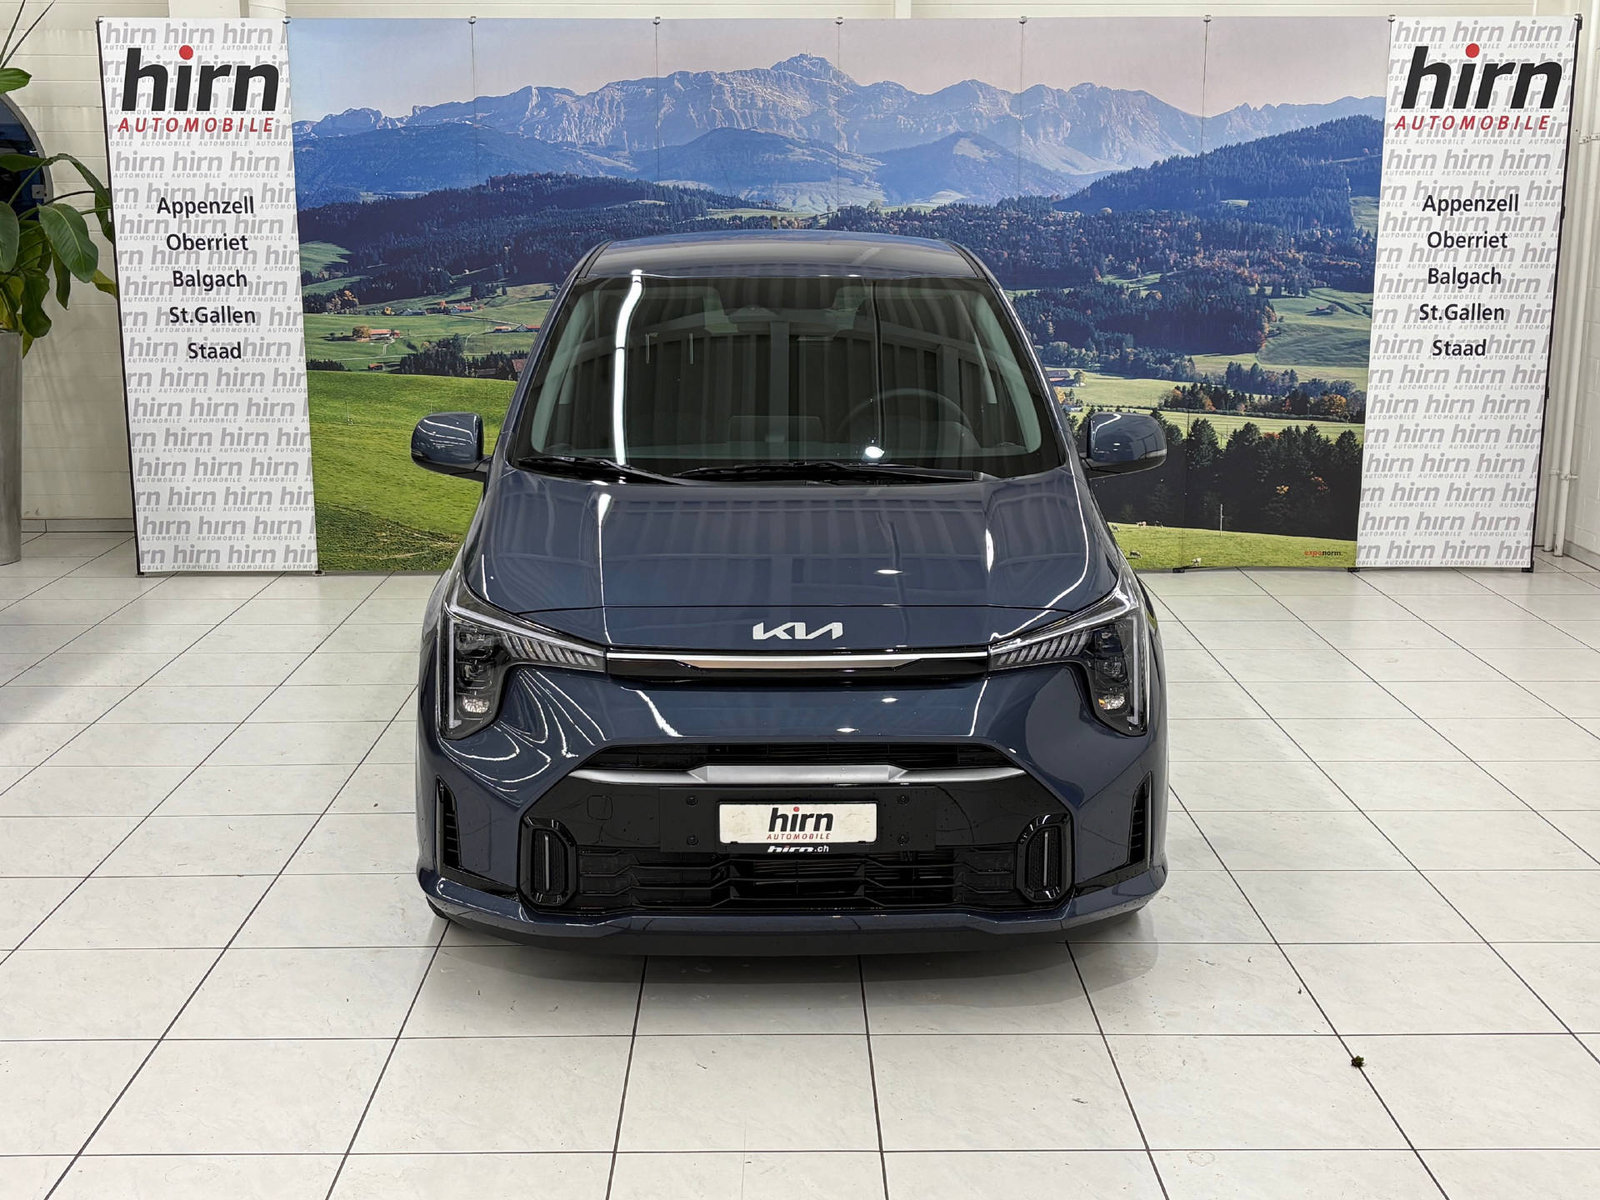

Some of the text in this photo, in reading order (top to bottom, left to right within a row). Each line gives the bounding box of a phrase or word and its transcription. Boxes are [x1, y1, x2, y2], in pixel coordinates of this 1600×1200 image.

[106, 23, 272, 44] hirn hirn hirn
[1395, 20, 1562, 42] hirn hirn hirn
[122, 45, 278, 111] hirn
[1401, 43, 1562, 109] hirn
[118, 117, 272, 132] AUTOMOBILE
[1395, 115, 1549, 130] AUTOMOBILE
[115, 151, 280, 171] hirn hirn hirn
[1387, 148, 1551, 169] hirn hirn hirn
[157, 196, 254, 219] Appenzell
[1422, 194, 1519, 216] Appenzell
[167, 233, 249, 251] Oberriet
[1427, 230, 1508, 249] Oberriet
[173, 270, 247, 291] Balgach
[1428, 267, 1502, 289] Balgach
[170, 305, 256, 323] St.Gallen
[1419, 303, 1504, 320] St.Gallen
[129, 337, 178, 357] hirn
[243, 337, 291, 356] hirn
[188, 342, 242, 359] Staad
[1374, 334, 1423, 353] hirn
[1486, 334, 1536, 353] hirn
[1432, 339, 1487, 356] Staad
[160, 367, 208, 387] hirn
[216, 367, 265, 386] hirn
[1400, 364, 1449, 383] hirn
[1456, 364, 1505, 383] hirn
[134, 397, 295, 417] hirn hirn hirn
[1370, 394, 1530, 413] hirn hirn hirn
[164, 427, 212, 446] hirn
[220, 427, 268, 446] hirn
[1395, 423, 1444, 443] hirn
[1451, 424, 1500, 443] hirn
[138, 457, 298, 476] hirn hirn hirn
[1366, 453, 1525, 472] hirn hirn hirn
[168, 486, 216, 505] hirn
[224, 486, 272, 505] hirn
[1391, 482, 1440, 501] hirn
[1446, 482, 1495, 501] hirn
[173, 544, 220, 564] hirn
[228, 545, 276, 563] hirn
[1387, 540, 1435, 559] hirn
[1442, 540, 1490, 559] hirn
[753, 622, 843, 640] KIA
[767, 806, 834, 832] hirn
[767, 845, 829, 853] hirn.ch
